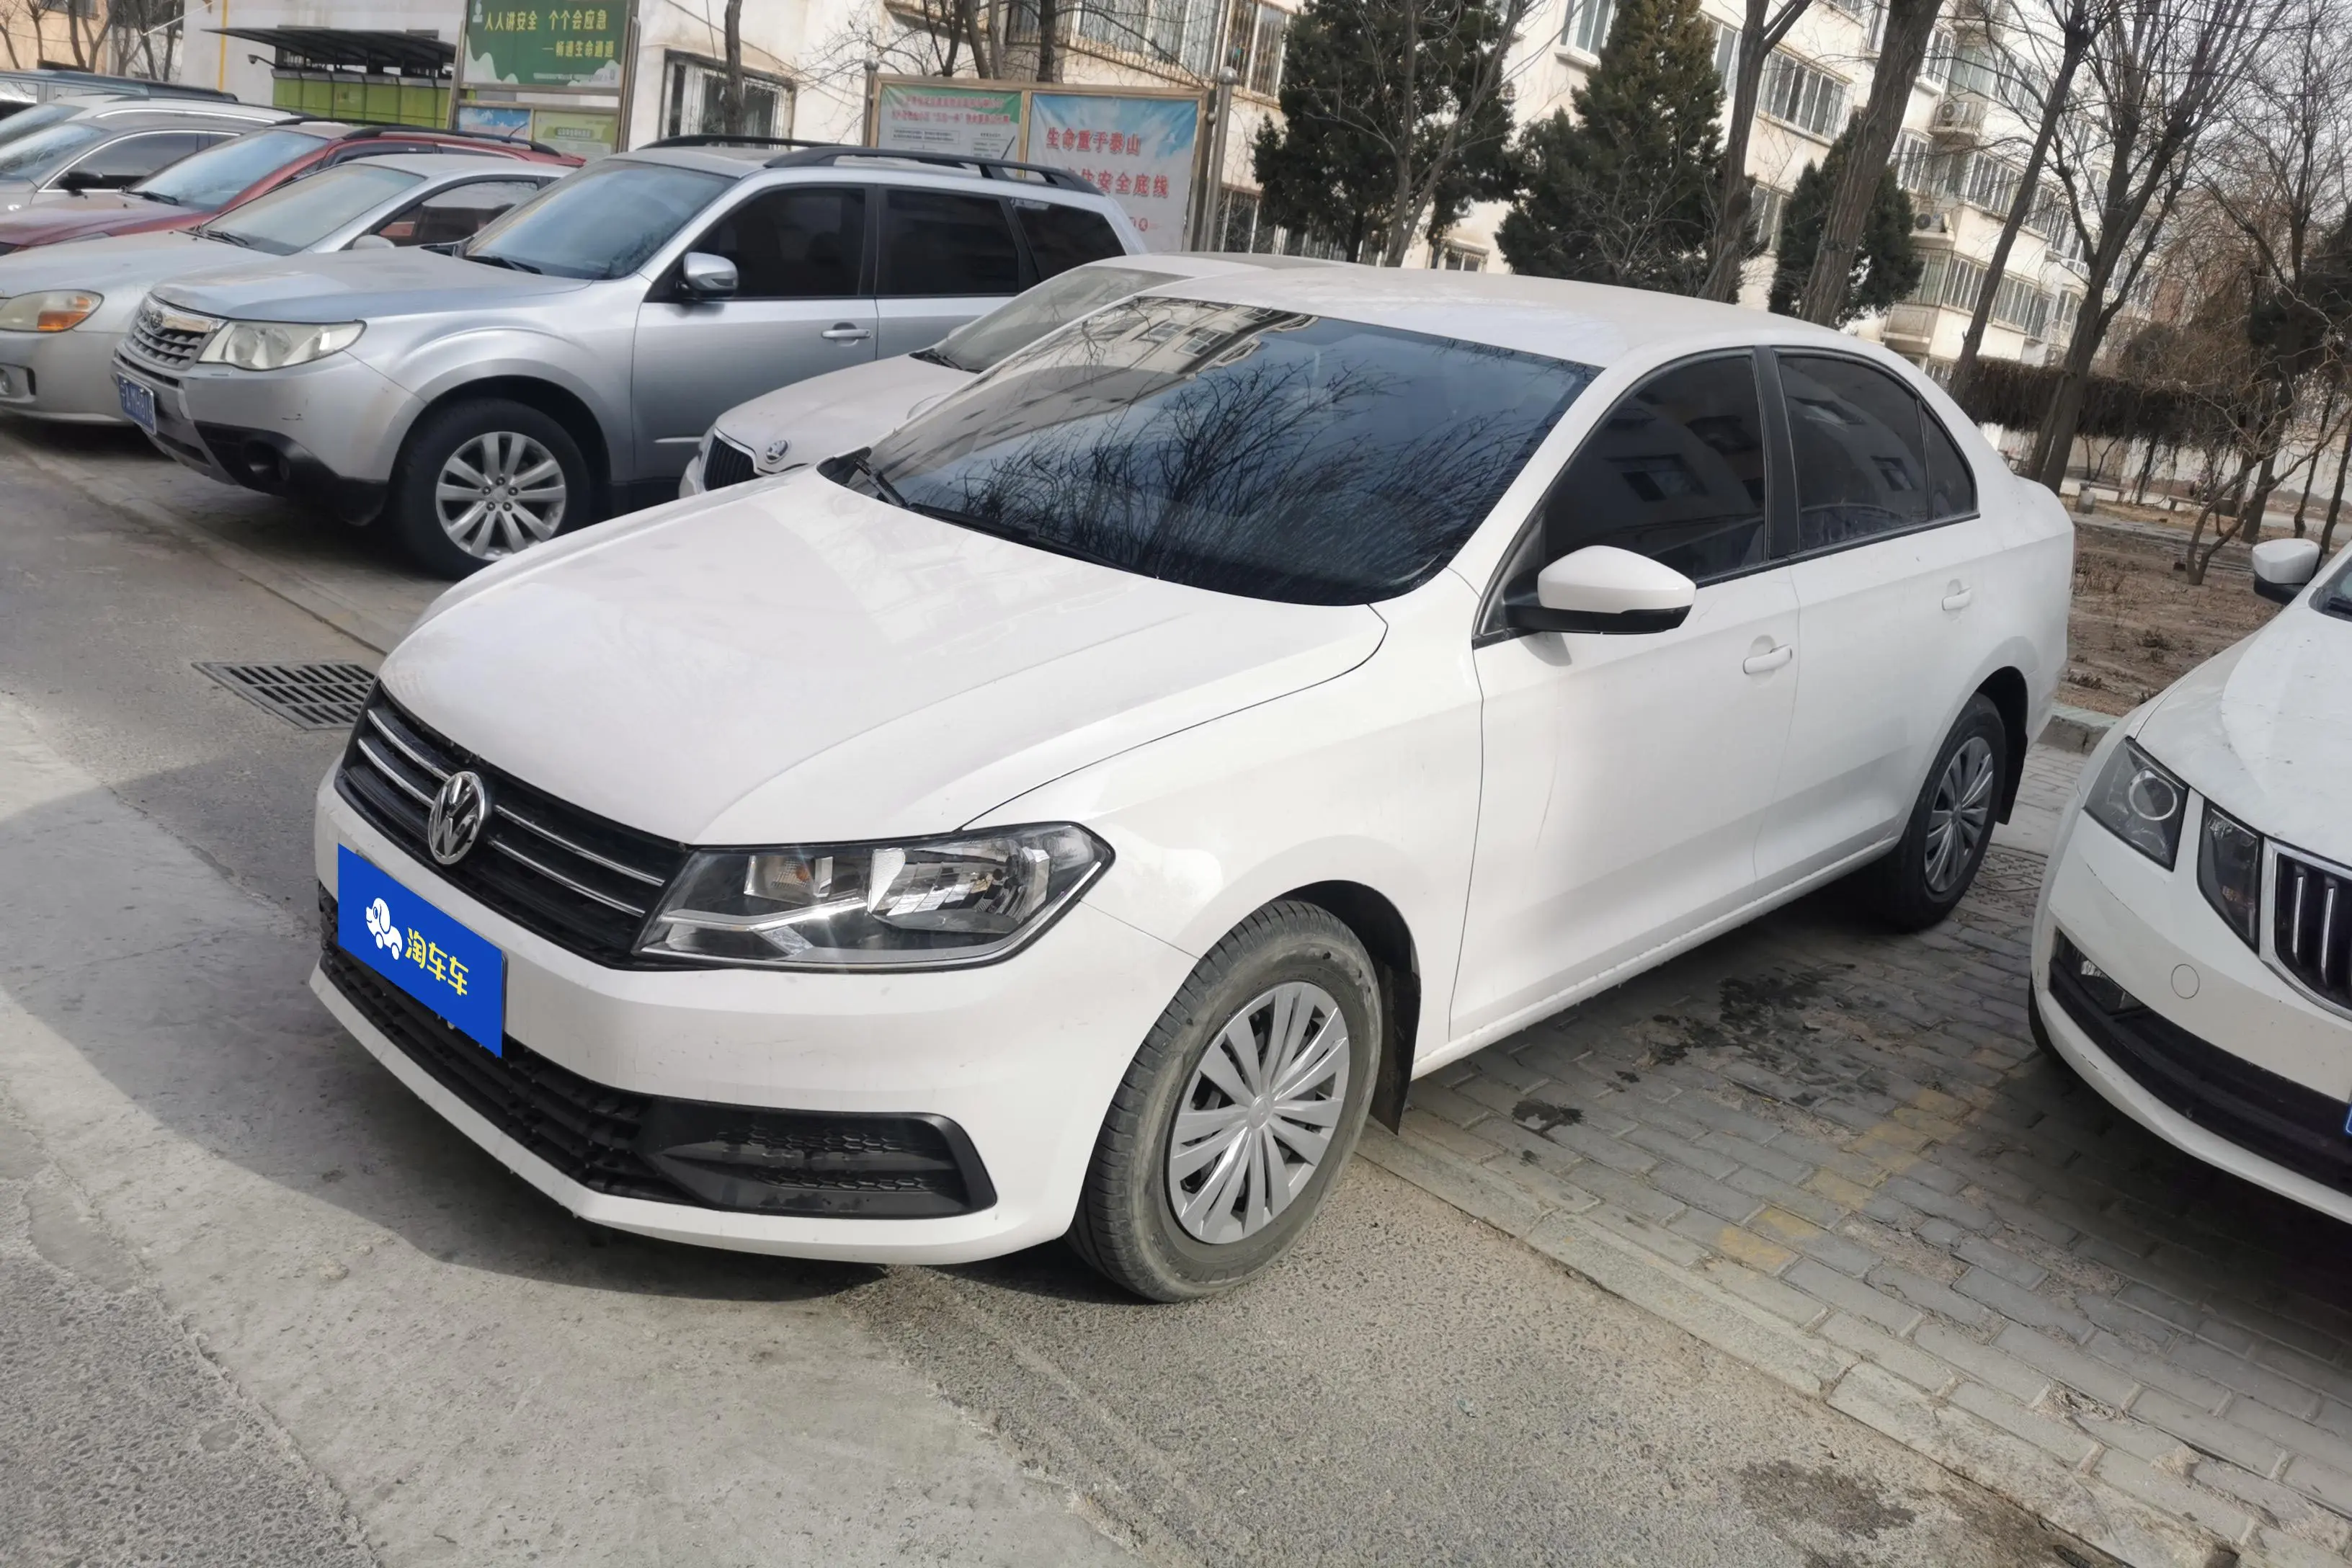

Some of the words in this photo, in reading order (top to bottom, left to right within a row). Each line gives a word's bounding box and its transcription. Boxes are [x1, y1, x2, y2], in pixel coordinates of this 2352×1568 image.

[484, 10, 538, 31] 人人讲安全
[548, 9, 607, 31] 个个会应急
[1046, 126, 1141, 156] 生命重于泰山
